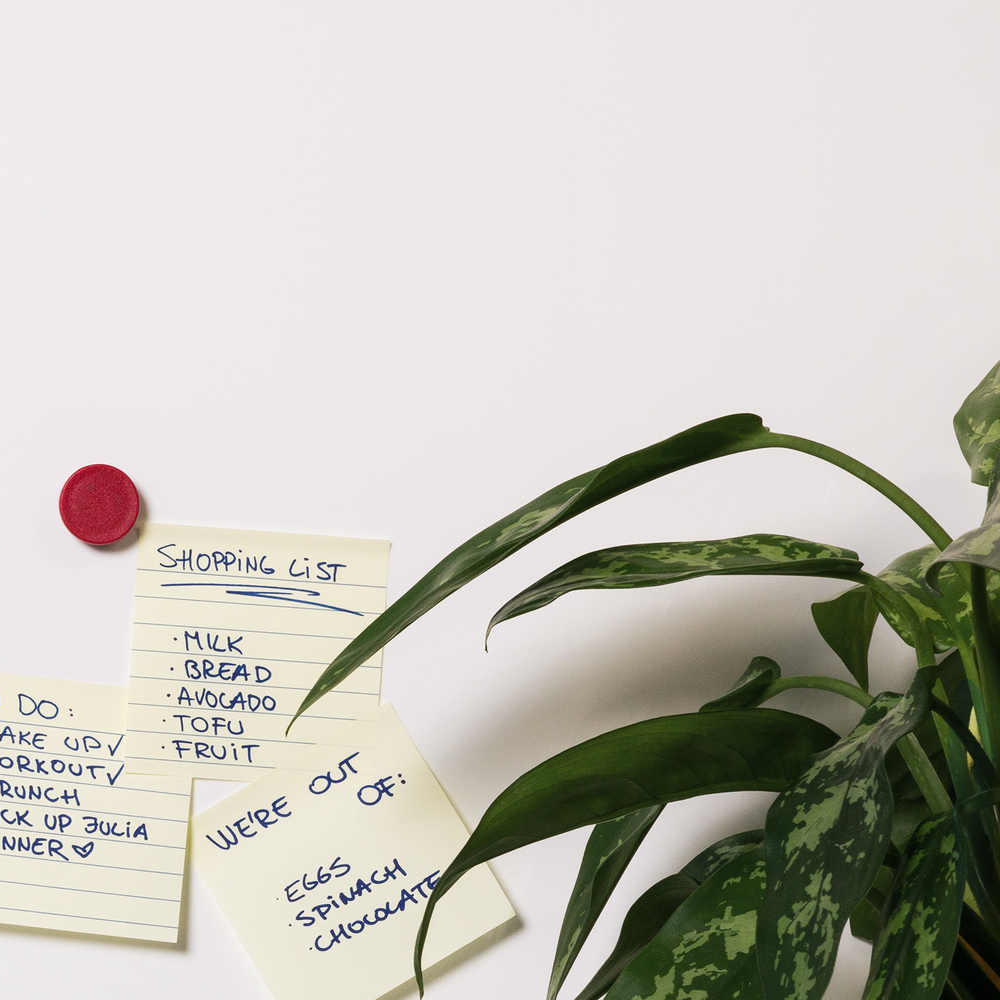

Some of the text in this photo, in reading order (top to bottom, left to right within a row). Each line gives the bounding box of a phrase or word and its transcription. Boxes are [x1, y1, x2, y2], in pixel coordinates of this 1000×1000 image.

[183, 630, 244, 655] MILK
[184, 659, 272, 684] BREAD
[177, 686, 277, 713] AVOCADO
[172, 714, 245, 736] TOFU
[63, 735, 102, 753] UP
[205, 751, 360, 851] WE'RE OUT
[356, 772, 407, 806] OF:
[44, 813, 73, 834] UP
[284, 856, 351, 903] EGGS
[314, 869, 440, 952] CHOCOLATE
